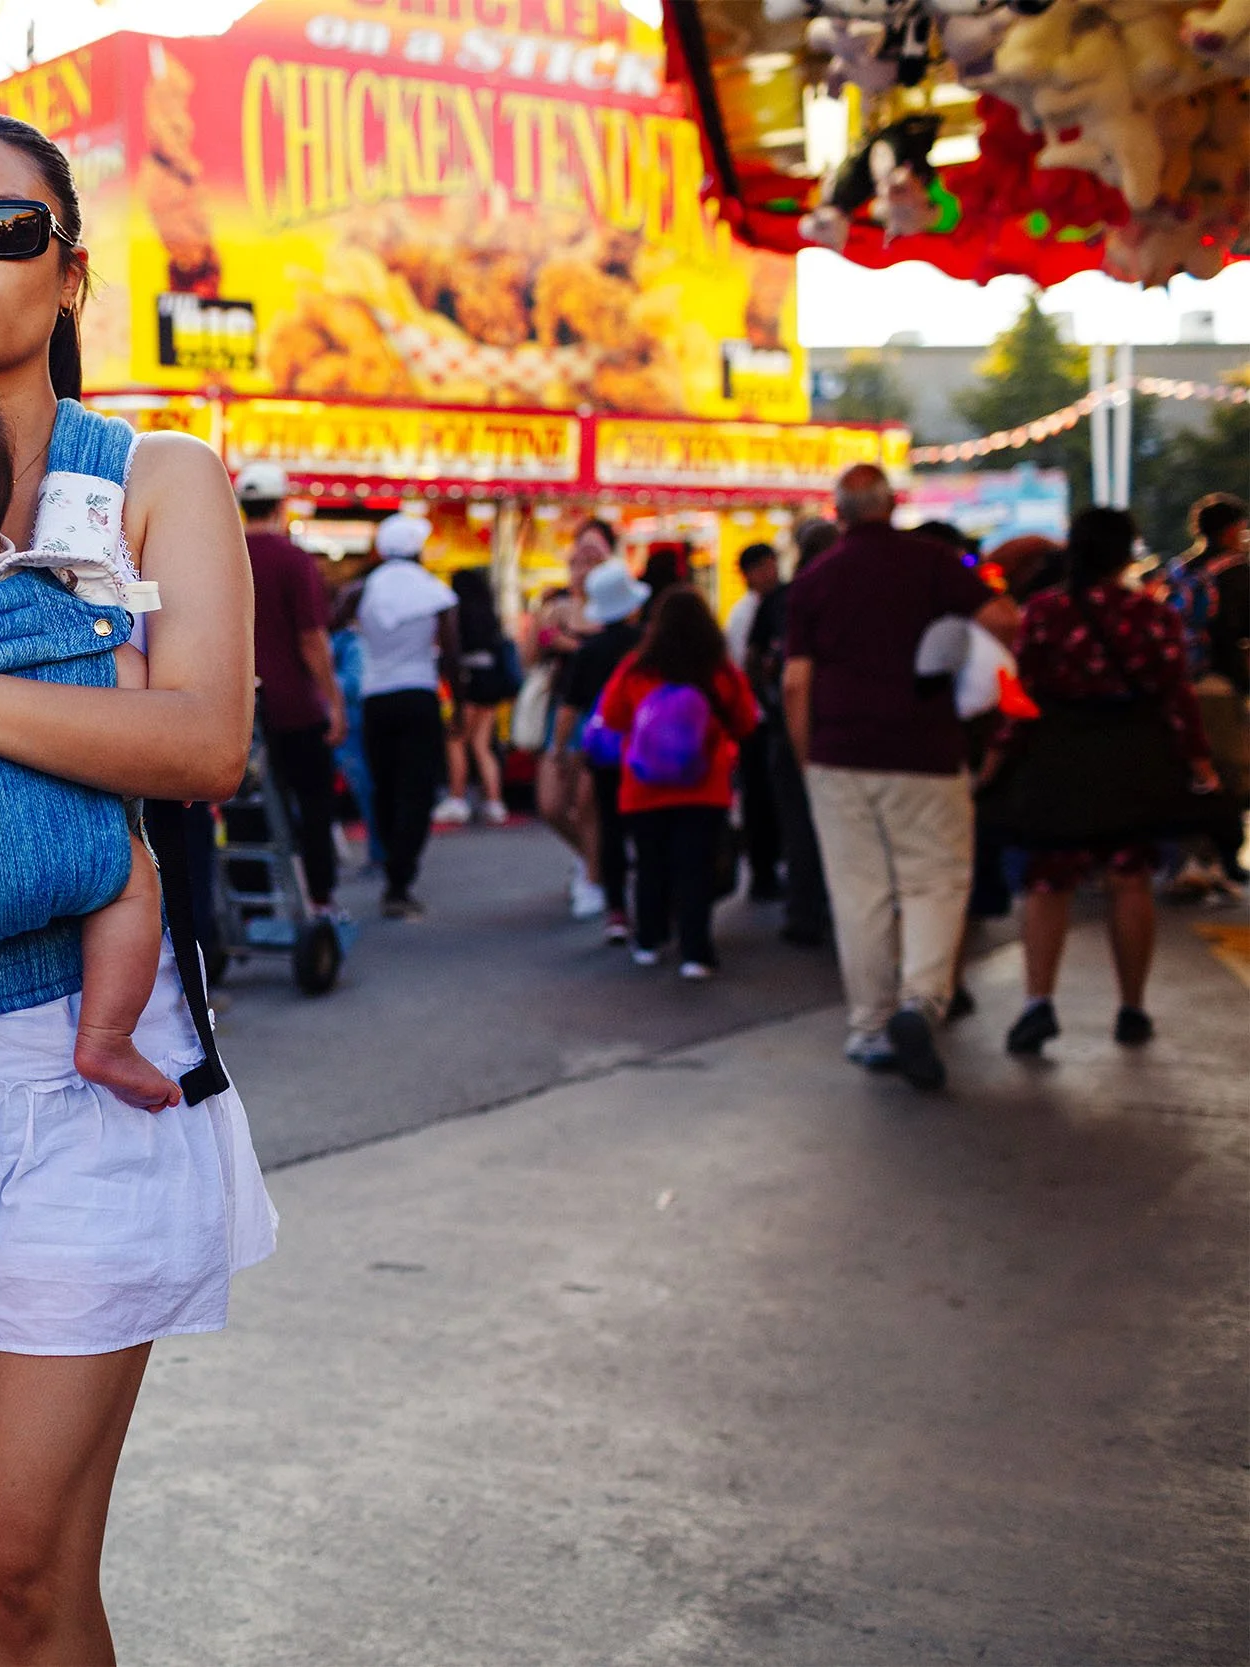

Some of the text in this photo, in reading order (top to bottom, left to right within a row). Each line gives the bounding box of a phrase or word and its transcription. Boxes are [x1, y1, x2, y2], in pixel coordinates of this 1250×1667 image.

[305, 14, 662, 99] on a STICK
[241, 56, 496, 234] CHICKEN
[229, 412, 402, 465] CHICKEN
